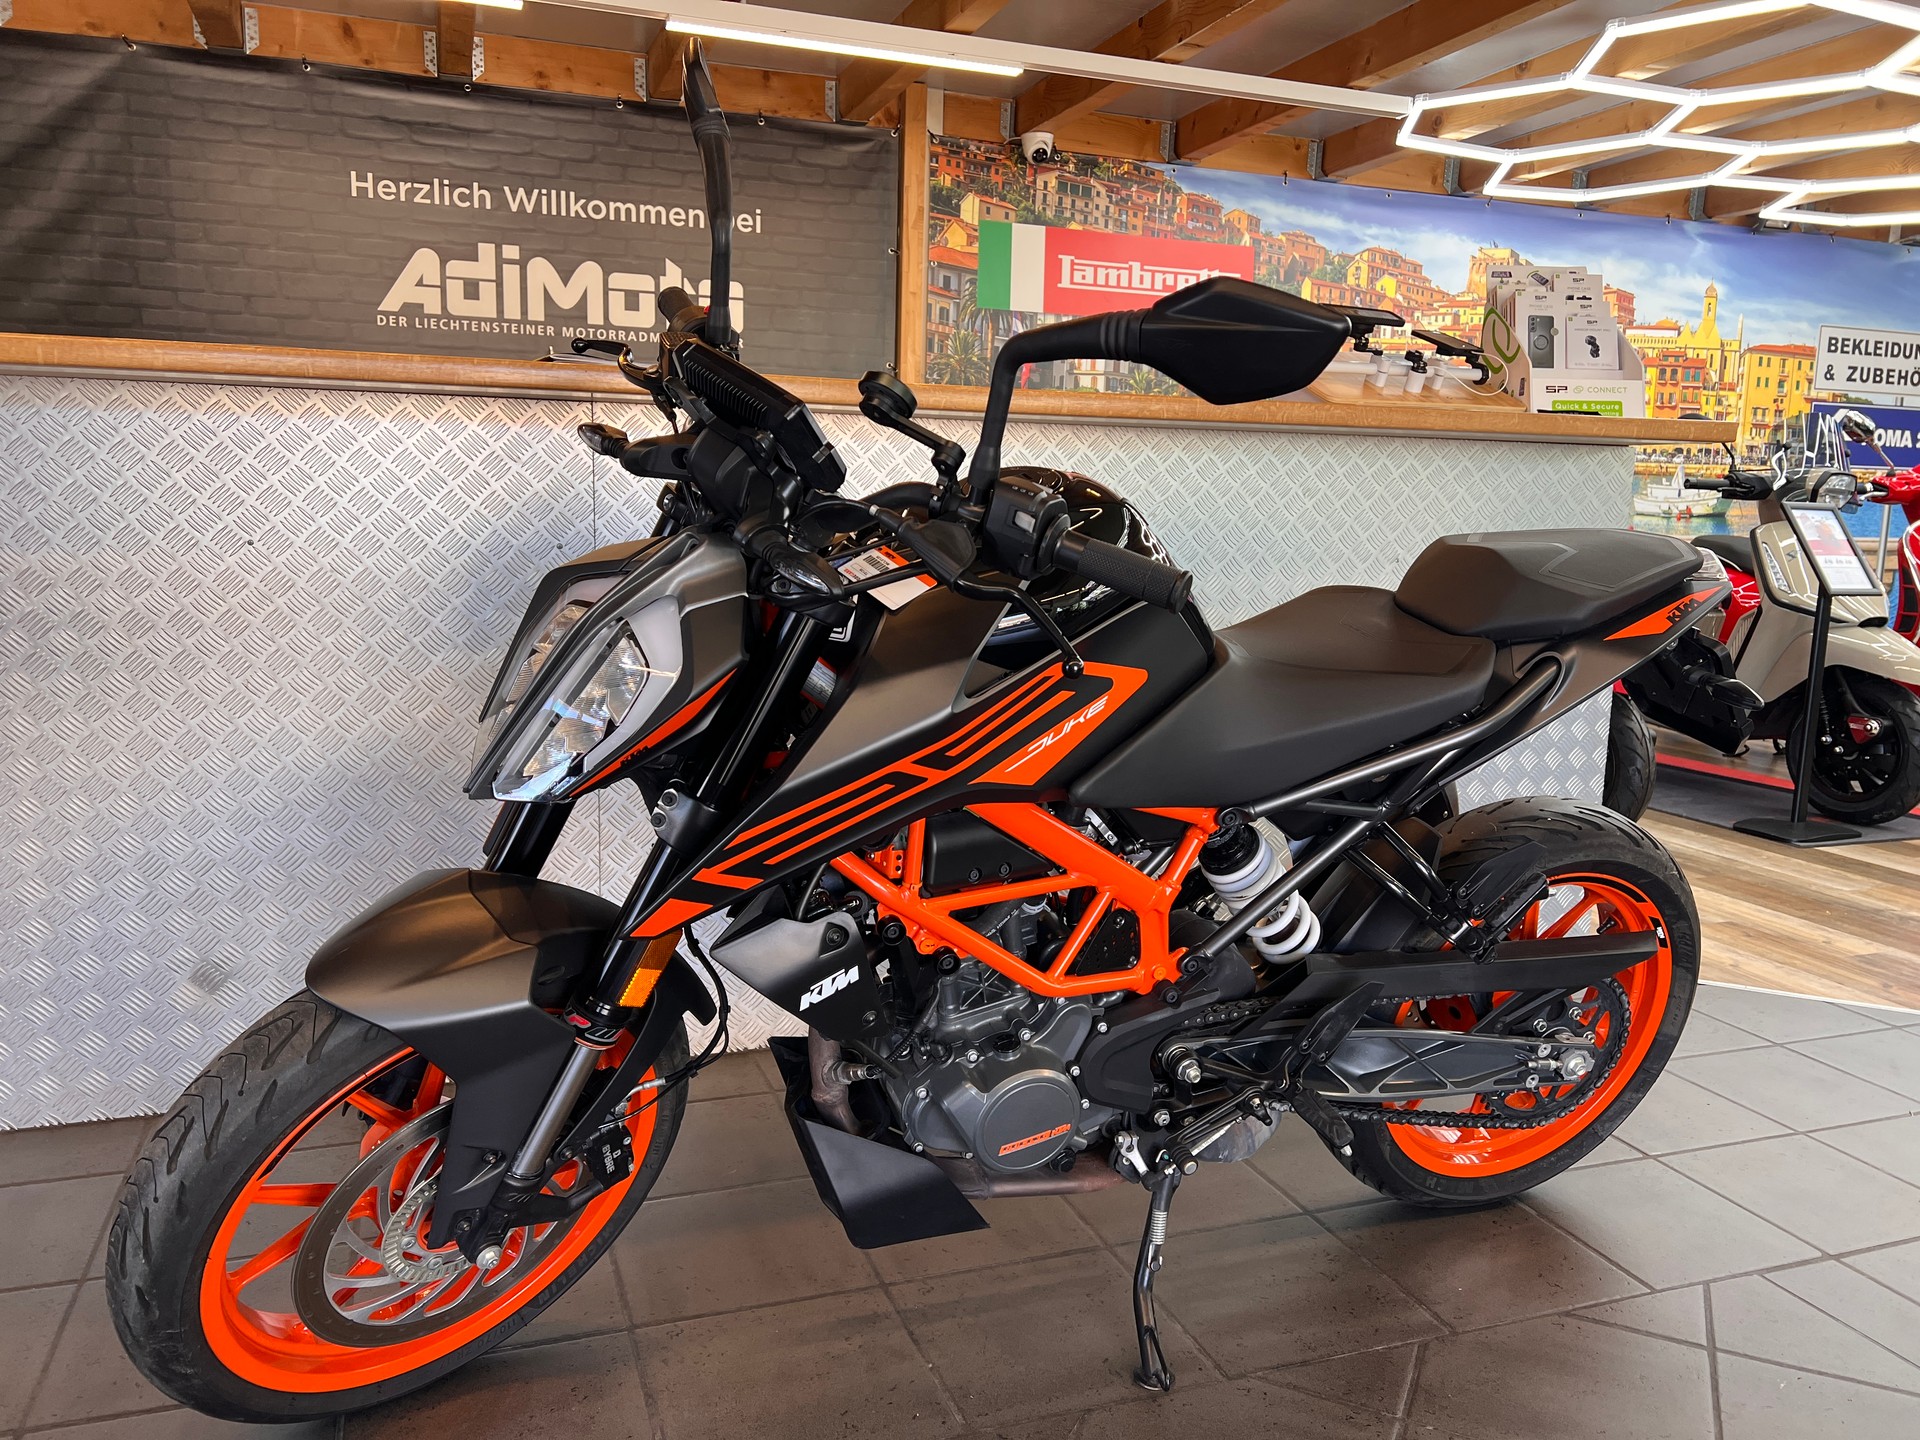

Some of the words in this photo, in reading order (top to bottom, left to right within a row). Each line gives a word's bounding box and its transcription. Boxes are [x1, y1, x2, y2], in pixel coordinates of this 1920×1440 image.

[350, 171, 492, 210] Herzlich
[503, 186, 705, 229] Willkommen
[732, 208, 761, 233] ei
[376, 314, 408, 328] DER
[415, 317, 555, 337] LIECHTENSTEINER
[1824, 364, 1835, 381] &
[1546, 385, 1568, 393] SP
[1587, 386, 1628, 394] CONNECT
[1555, 402, 1580, 410] Quick
[1582, 402, 1588, 410] &
[1591, 402, 1620, 410] Secure
[1861, 428, 1913, 448] OMA
[1665, 598, 1700, 624] KTM
[1004, 695, 1109, 773] DUKE
[799, 965, 860, 1012] KTM
[602, 1144, 615, 1174] BYBRE
